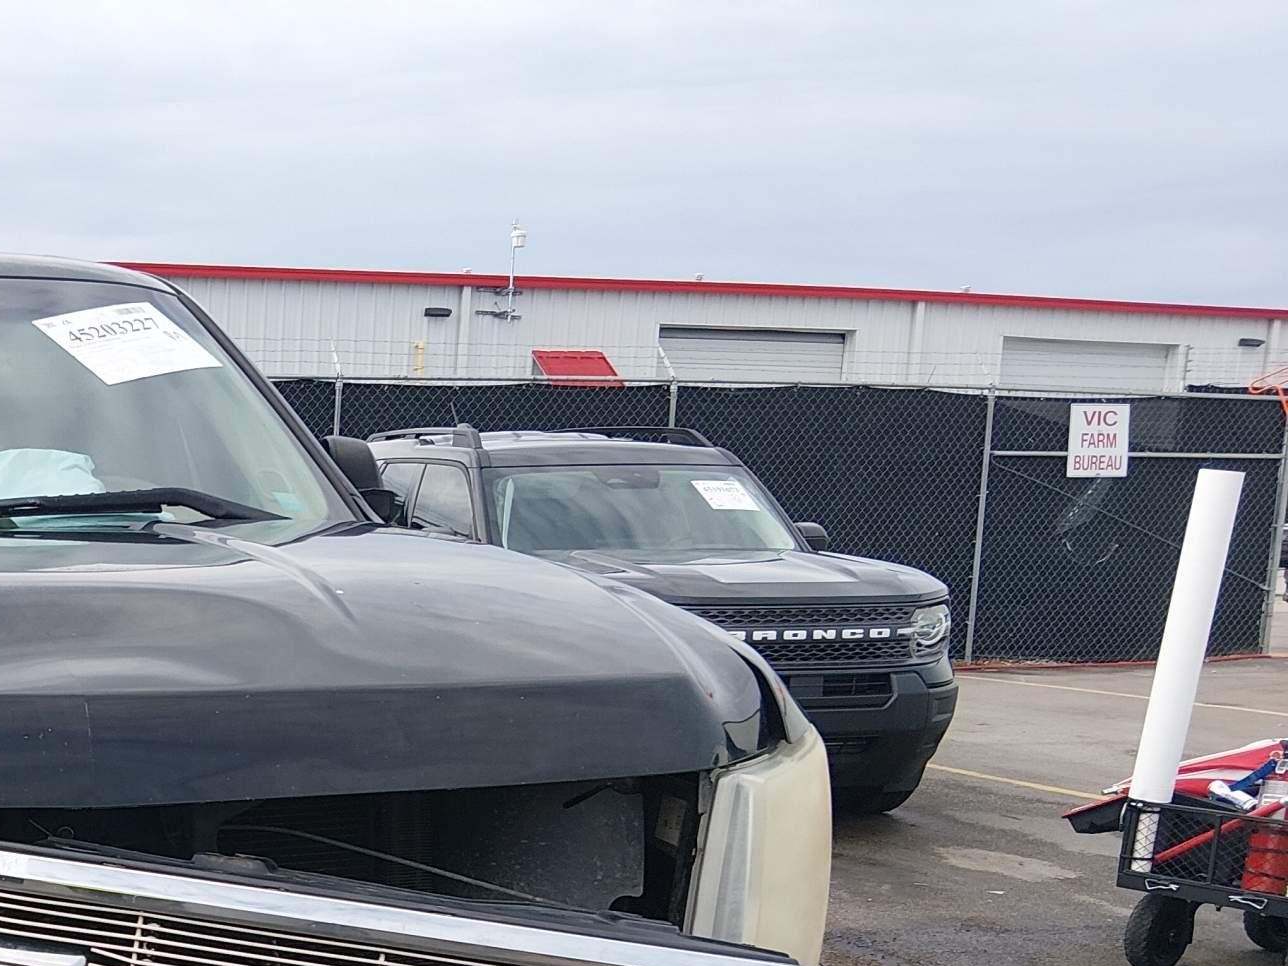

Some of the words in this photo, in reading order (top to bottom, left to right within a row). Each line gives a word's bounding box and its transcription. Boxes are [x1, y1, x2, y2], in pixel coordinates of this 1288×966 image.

[68, 317, 159, 343] 45203227
[1082, 410, 1119, 427] VIC
[1080, 432, 1118, 449] FARM
[1073, 454, 1123, 471] BUREAU
